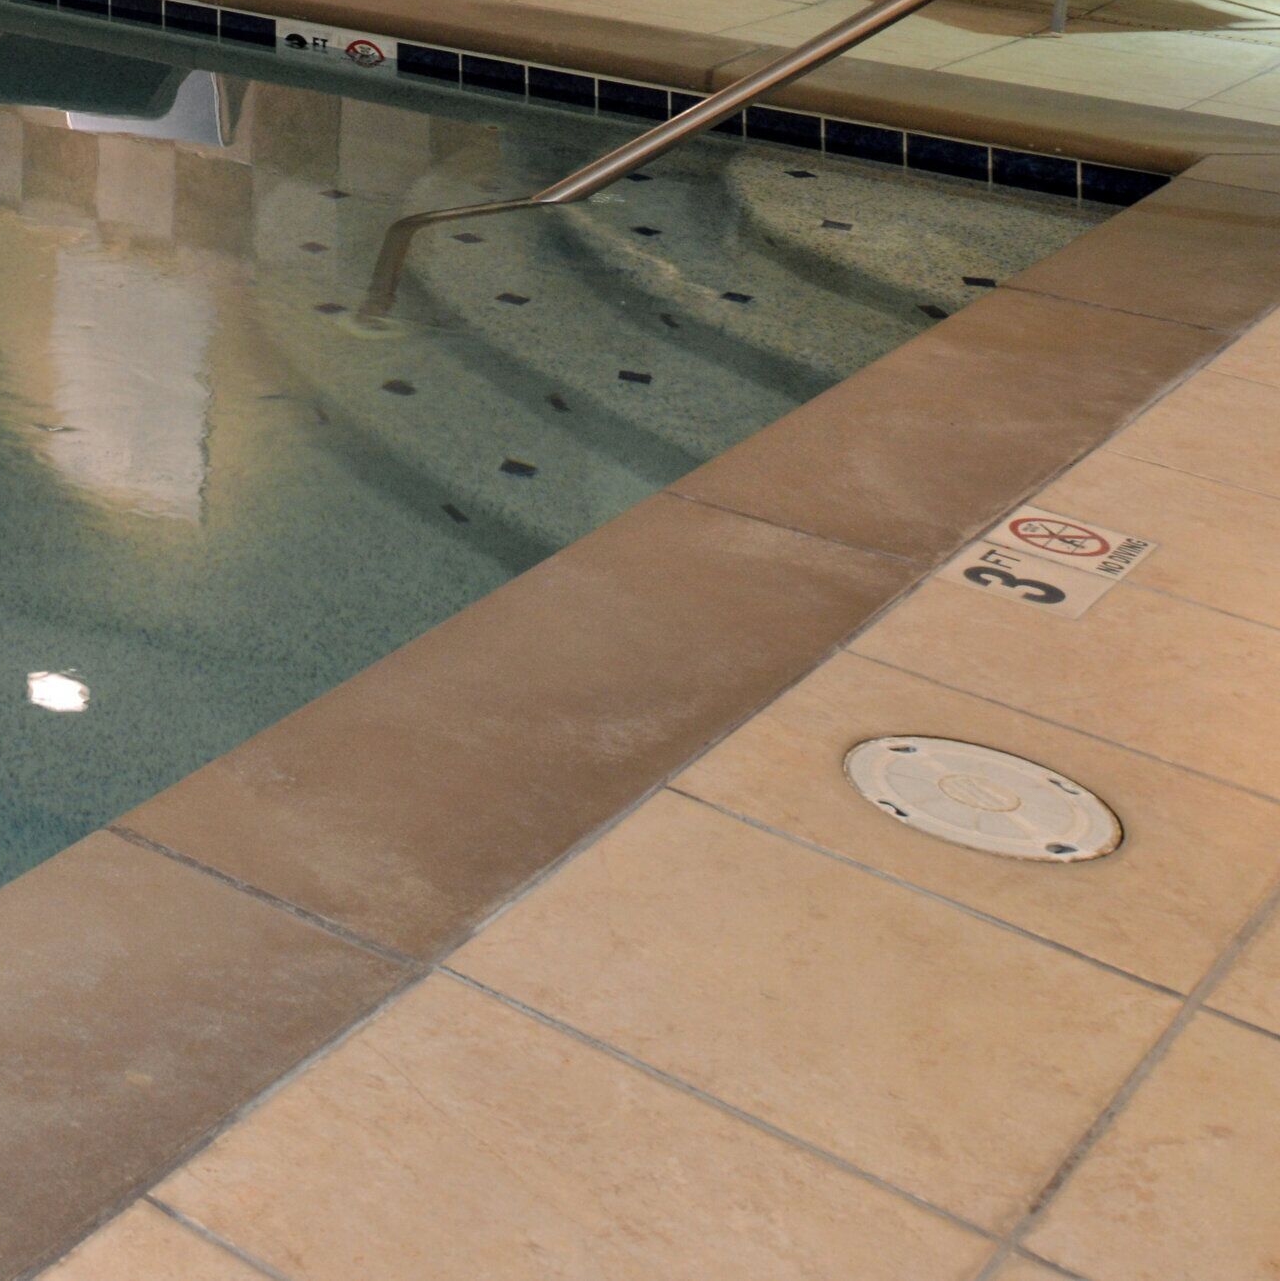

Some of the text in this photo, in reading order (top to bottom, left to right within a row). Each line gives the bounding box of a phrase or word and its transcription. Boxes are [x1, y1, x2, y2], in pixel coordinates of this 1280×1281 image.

[963, 549, 1066, 605] 3 FT
[1096, 538, 1149, 575] NO DIVING
